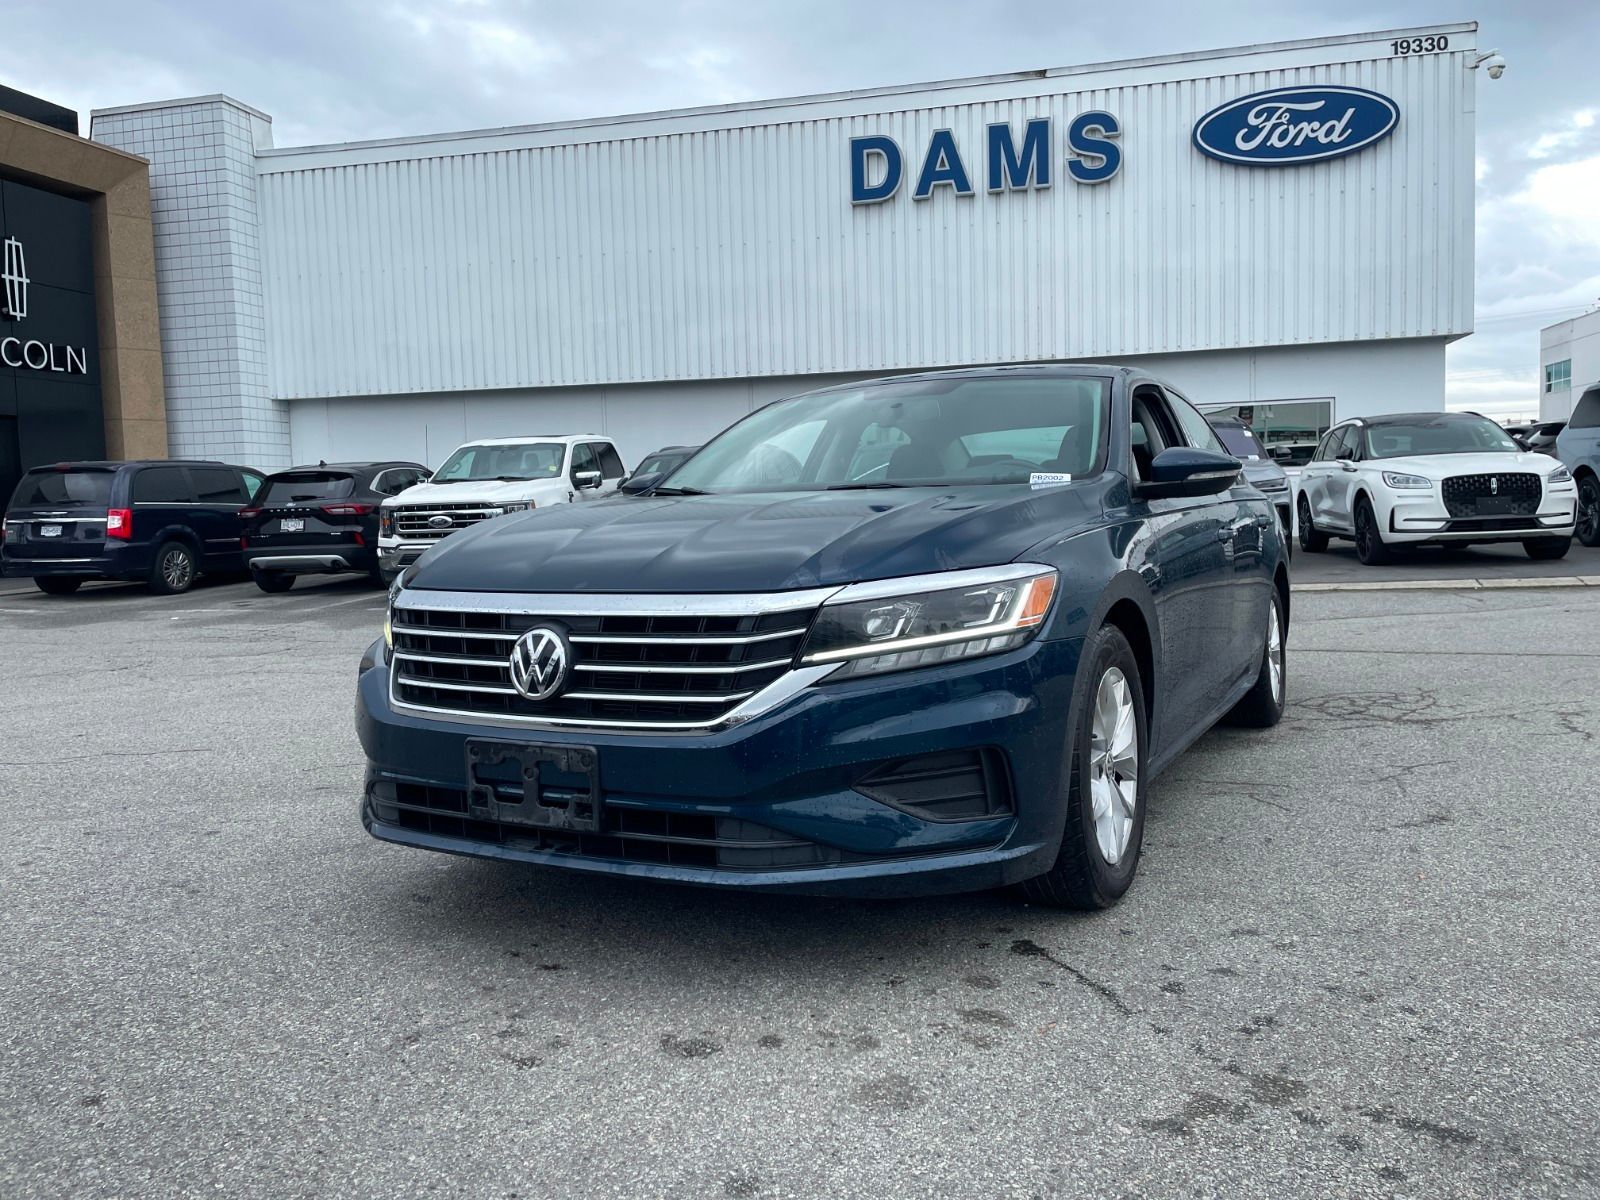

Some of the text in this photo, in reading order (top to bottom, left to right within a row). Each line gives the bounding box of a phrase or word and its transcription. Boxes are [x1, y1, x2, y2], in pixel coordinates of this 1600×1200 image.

[1390, 35, 1449, 56] 19330
[1234, 99, 1356, 151] Ford
[849, 110, 1122, 205] DAMS
